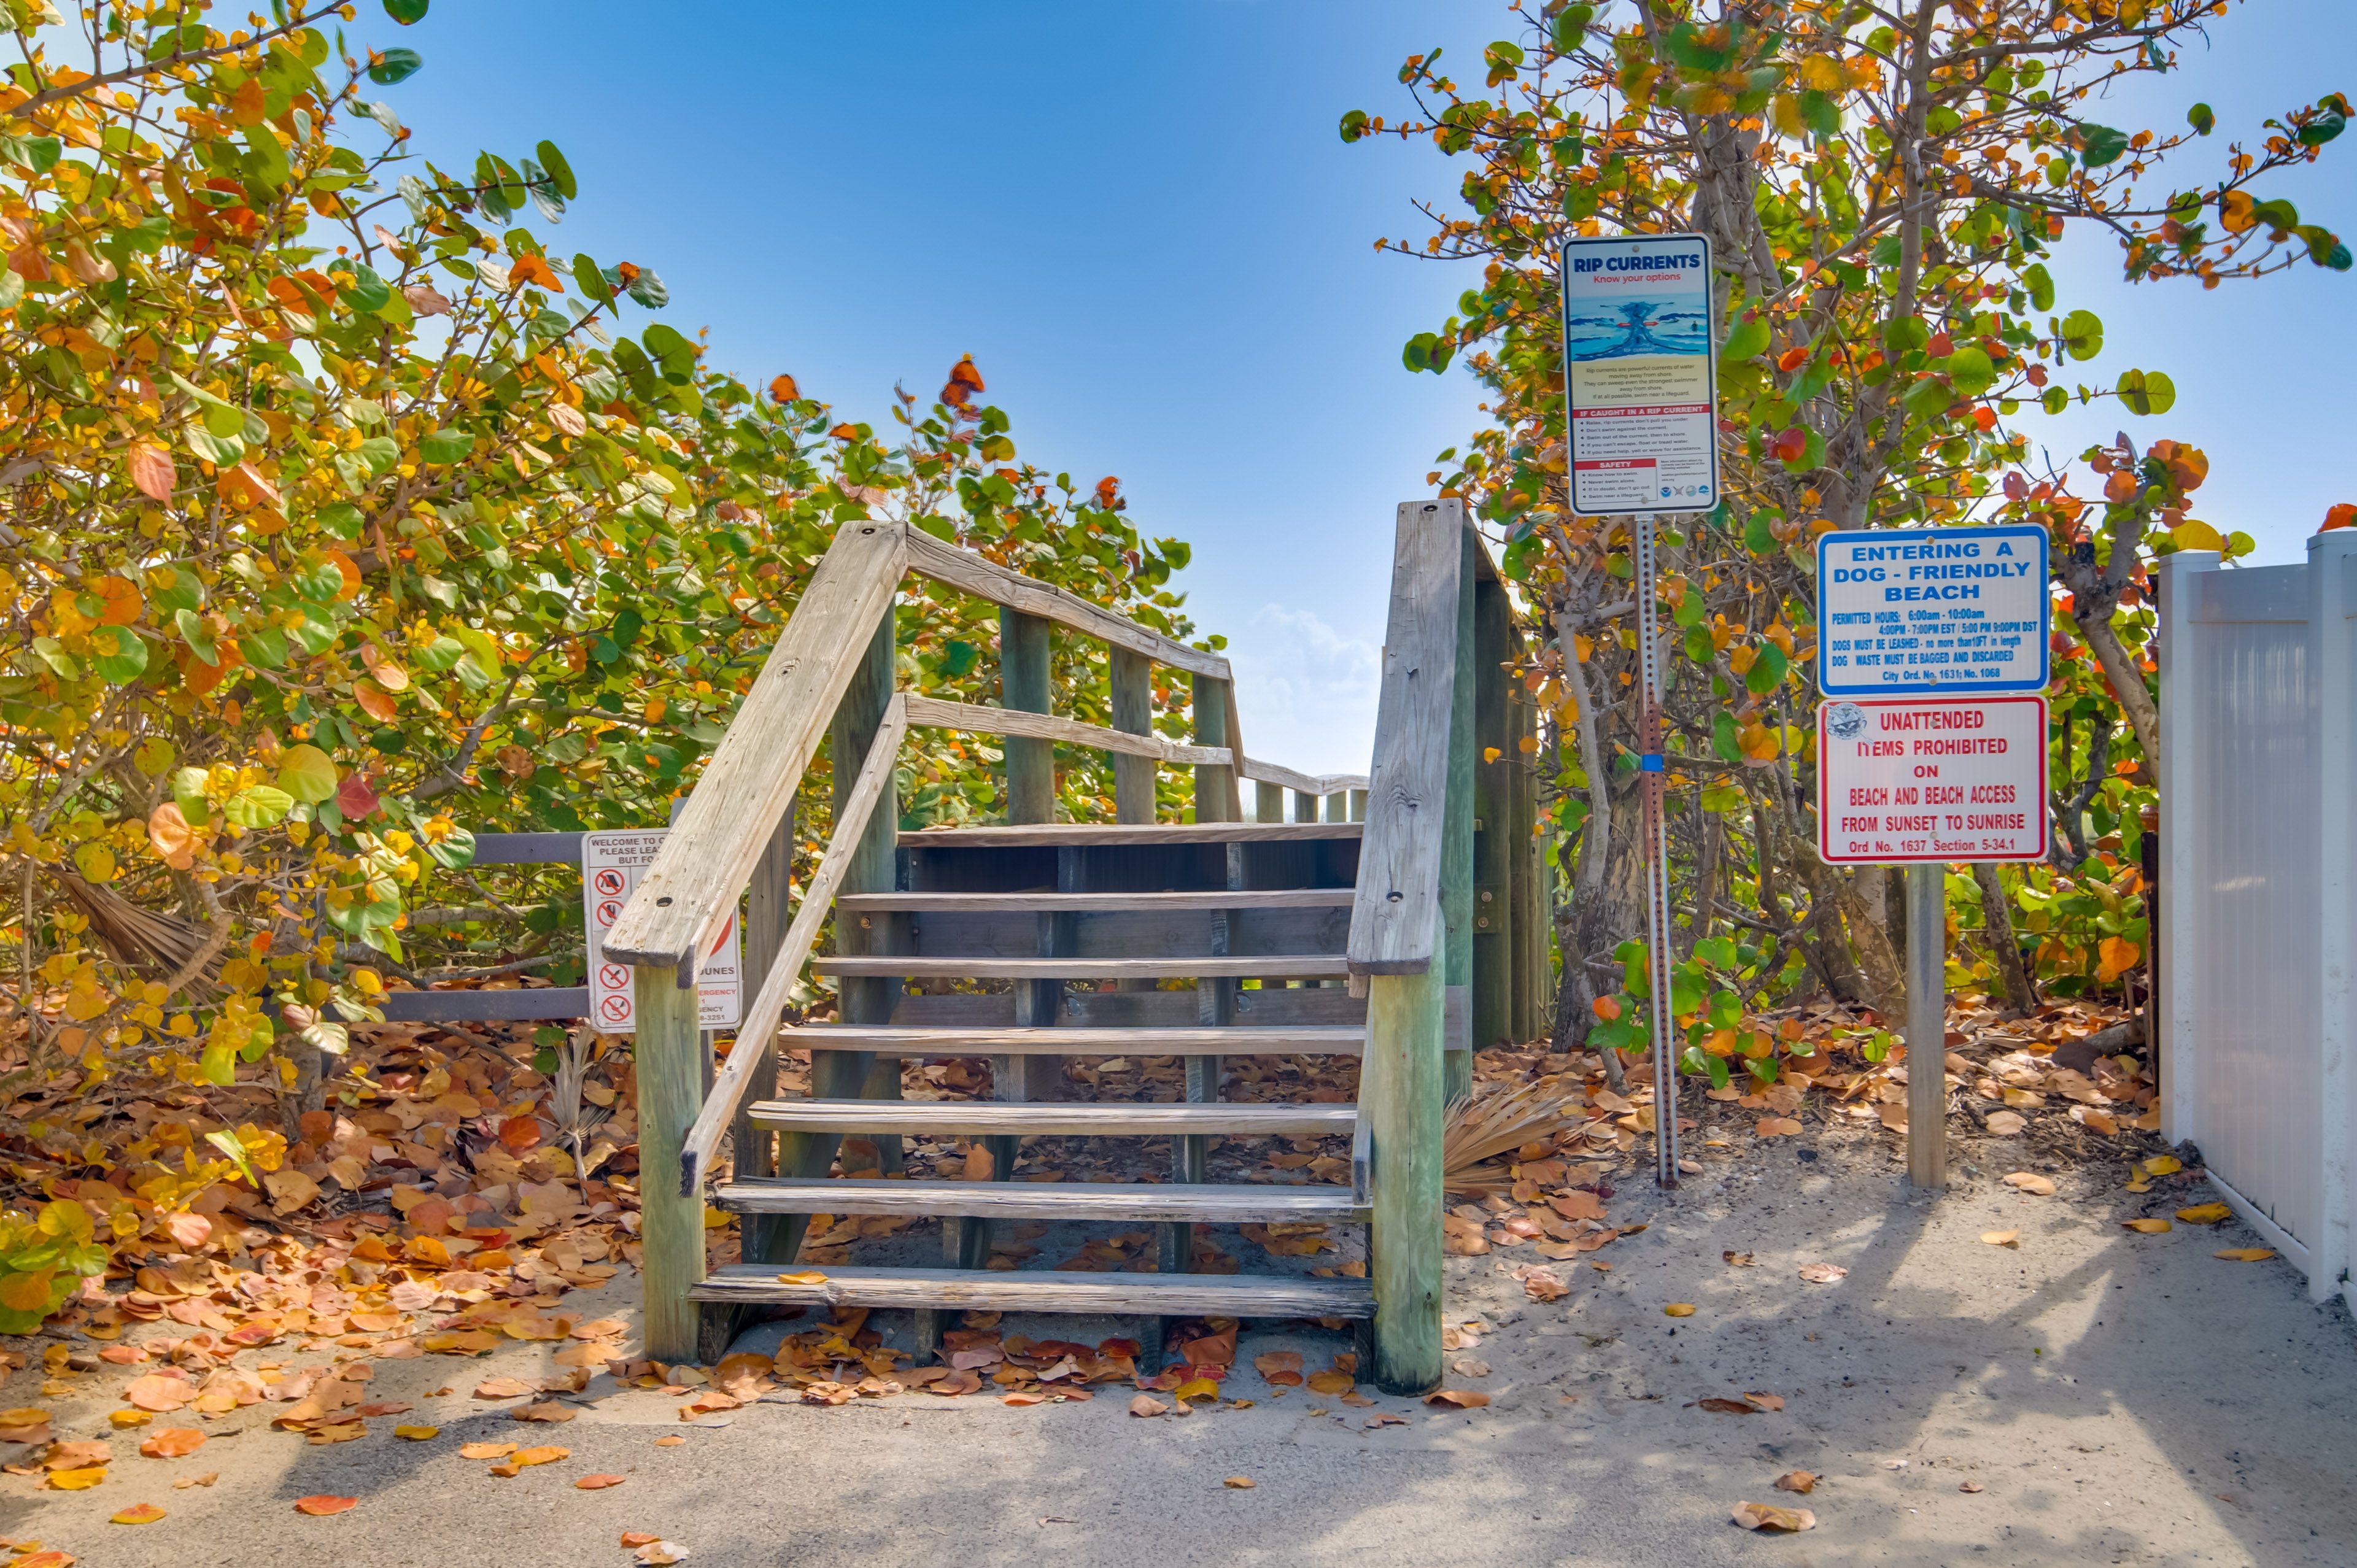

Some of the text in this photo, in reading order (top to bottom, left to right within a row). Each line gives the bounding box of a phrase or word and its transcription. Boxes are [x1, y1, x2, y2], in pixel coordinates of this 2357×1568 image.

[1574, 254, 1700, 272] RIP CURRENTS
[1852, 541, 2013, 561] ENTERING A
[1834, 562, 2030, 583] DOG FRIENDLY
[1885, 585, 1979, 601] BEACH
[1832, 609, 1984, 625] PERMITTED HOURS: 6:00am 10:00am
[1879, 622, 2037, 635] 4:00PM 7:00PM EST 5:00 PM 9:00PM DST
[1832, 639, 1851, 651] DOGS
[1854, 639, 1873, 650] MUST
[1876, 638, 1885, 650] BE
[1889, 638, 1918, 649] LEASHED
[1926, 639, 1933, 647] no
[1938, 638, 1954, 647] more
[1991, 636, 1997, 646] in
[2000, 635, 2021, 648] length
[1832, 650, 2013, 666] DOG WASTE MUST BE BAGGED AND DISCARDED
[1882, 671, 1899, 683] City
[1903, 670, 1921, 680] Ord.
[1922, 670, 1937, 679] No.
[1964, 669, 1978, 678] No.
[1980, 668, 2000, 678] 1068
[1880, 711, 1983, 730] UNATTENDED
[1914, 738, 2007, 755] PROHIBITED
[1913, 765, 1938, 778] ON
[1849, 785, 2015, 806] BEACH AND BEACH ACCESS
[1841, 814, 2024, 832] FROM SUNSET TO SUNRISE
[1849, 838, 2014, 853] Ord No. 1637 Section 5-34.1
